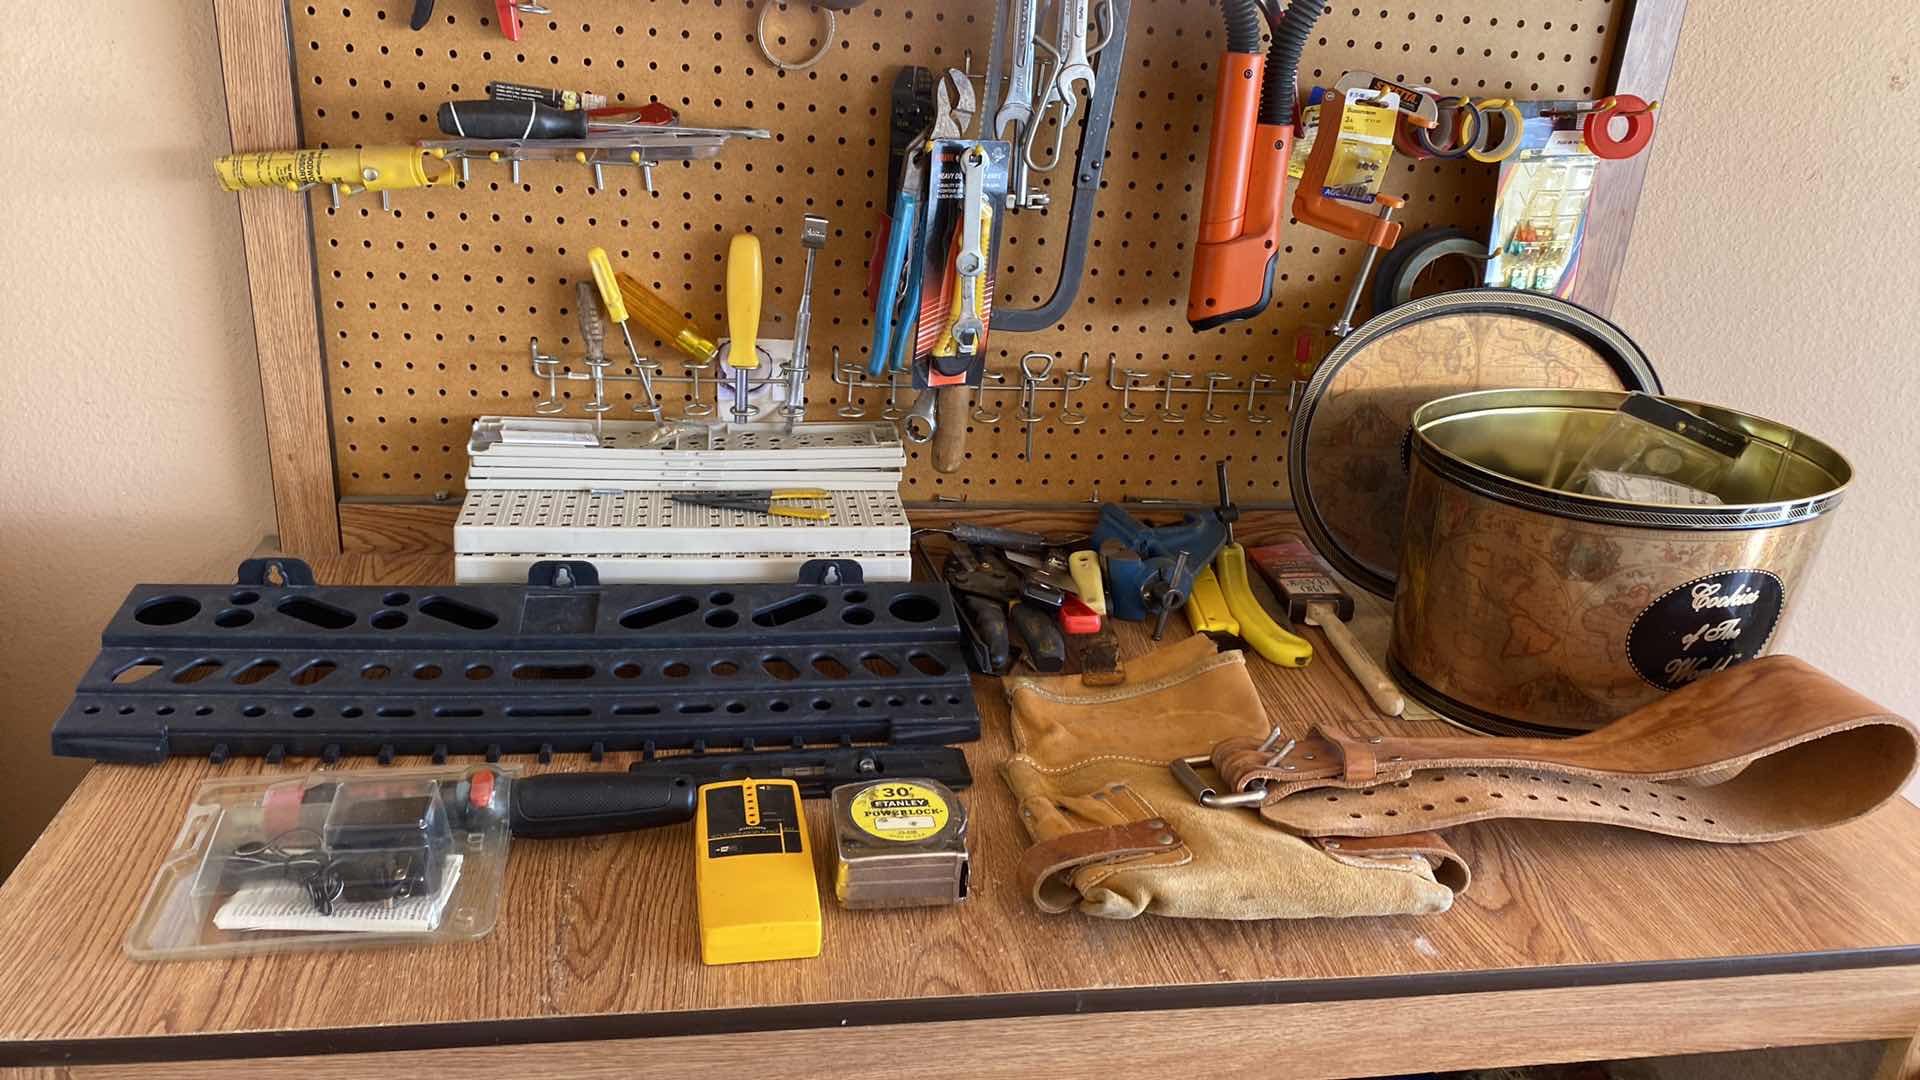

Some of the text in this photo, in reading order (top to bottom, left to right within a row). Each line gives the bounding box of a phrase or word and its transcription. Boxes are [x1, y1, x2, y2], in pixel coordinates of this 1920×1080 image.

[1691, 583, 1760, 612] Cookies
[1682, 618, 1742, 651] of The
[863, 808, 939, 817] POWERLOCK
[874, 799, 925, 807] STANLEY
